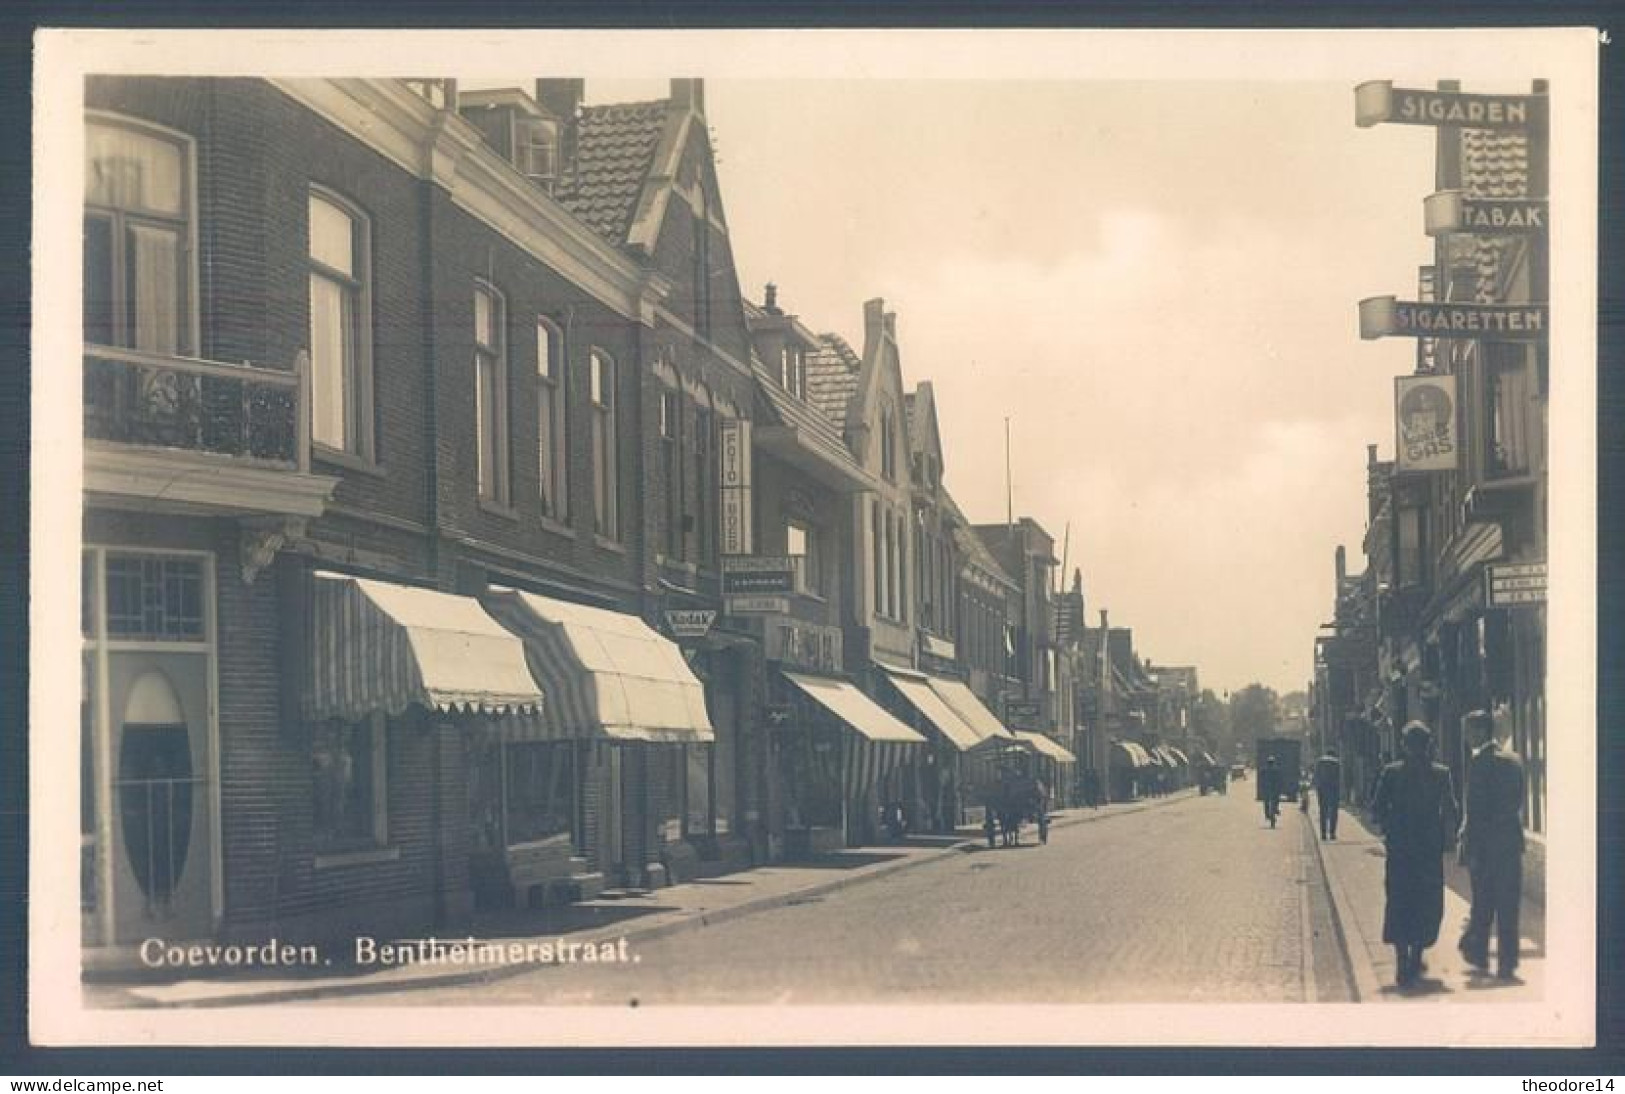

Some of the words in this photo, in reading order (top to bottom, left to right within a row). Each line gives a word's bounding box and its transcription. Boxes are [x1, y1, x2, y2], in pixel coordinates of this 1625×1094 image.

[1402, 96, 1526, 123] SIGAREN
[1463, 206, 1542, 227] TABAK
[1394, 308, 1542, 330] SIGARETTEN
[727, 433, 737, 482] FOTO
